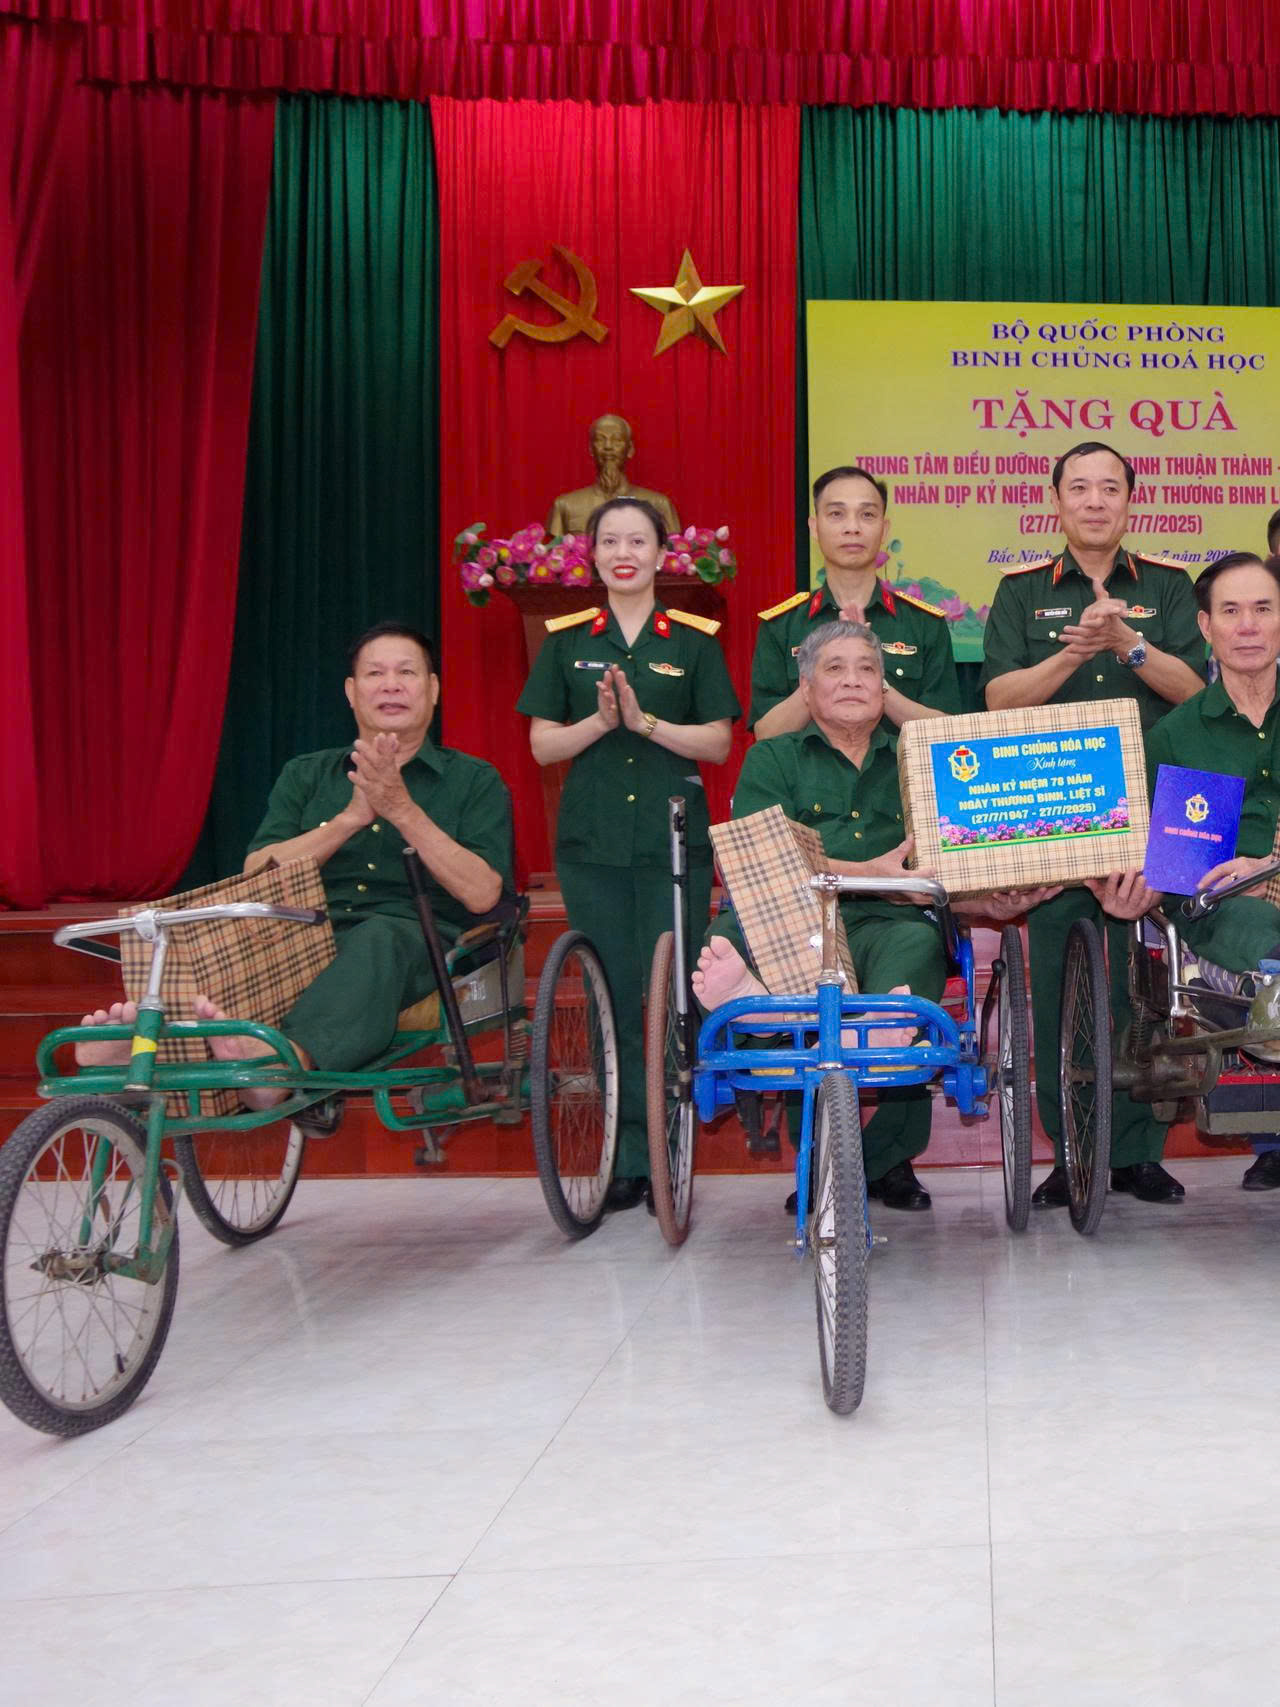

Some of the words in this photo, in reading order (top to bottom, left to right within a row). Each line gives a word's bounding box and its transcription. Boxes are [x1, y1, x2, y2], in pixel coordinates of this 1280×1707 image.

[992, 320, 1030, 344] BỘ
[1038, 319, 1117, 343] QUỐC
[1128, 322, 1225, 343] PHÒNG
[952, 351, 1021, 367] BINH
[1031, 346, 1131, 368] CHỦNG
[1141, 350, 1199, 369] HOÁ
[1207, 354, 1265, 374] HỌC
[972, 389, 1114, 438] TẶNG
[1129, 390, 1237, 436] QUÀ
[855, 456, 909, 475] TRUNG
[913, 452, 948, 475] TÂM
[996, 451, 1050, 475] DƯỠNG
[1165, 454, 1216, 479] THUẬN
[1221, 454, 1272, 476] THÀNH
[894, 481, 939, 504] NHÂN
[944, 485, 971, 508] DỊP
[976, 479, 996, 504] KỶ
[1002, 481, 1043, 508] NIỆM
[1161, 485, 1224, 505] THƯƠNG
[1229, 486, 1266, 504] BINH
[1126, 514, 1203, 535] 7/7/2025)
[988, 547, 1014, 563] Bắc
[1204, 550, 1237, 562] 202
[992, 746, 1019, 759] BINH
[1021, 740, 1058, 756] CHỦNG
[1084, 736, 1106, 752] HỌC
[968, 782, 1000, 795] NHÂN
[1067, 773, 1093, 785] NĂM
[959, 798, 989, 811] NGÀY
[1069, 787, 1092, 800] LIỆT
